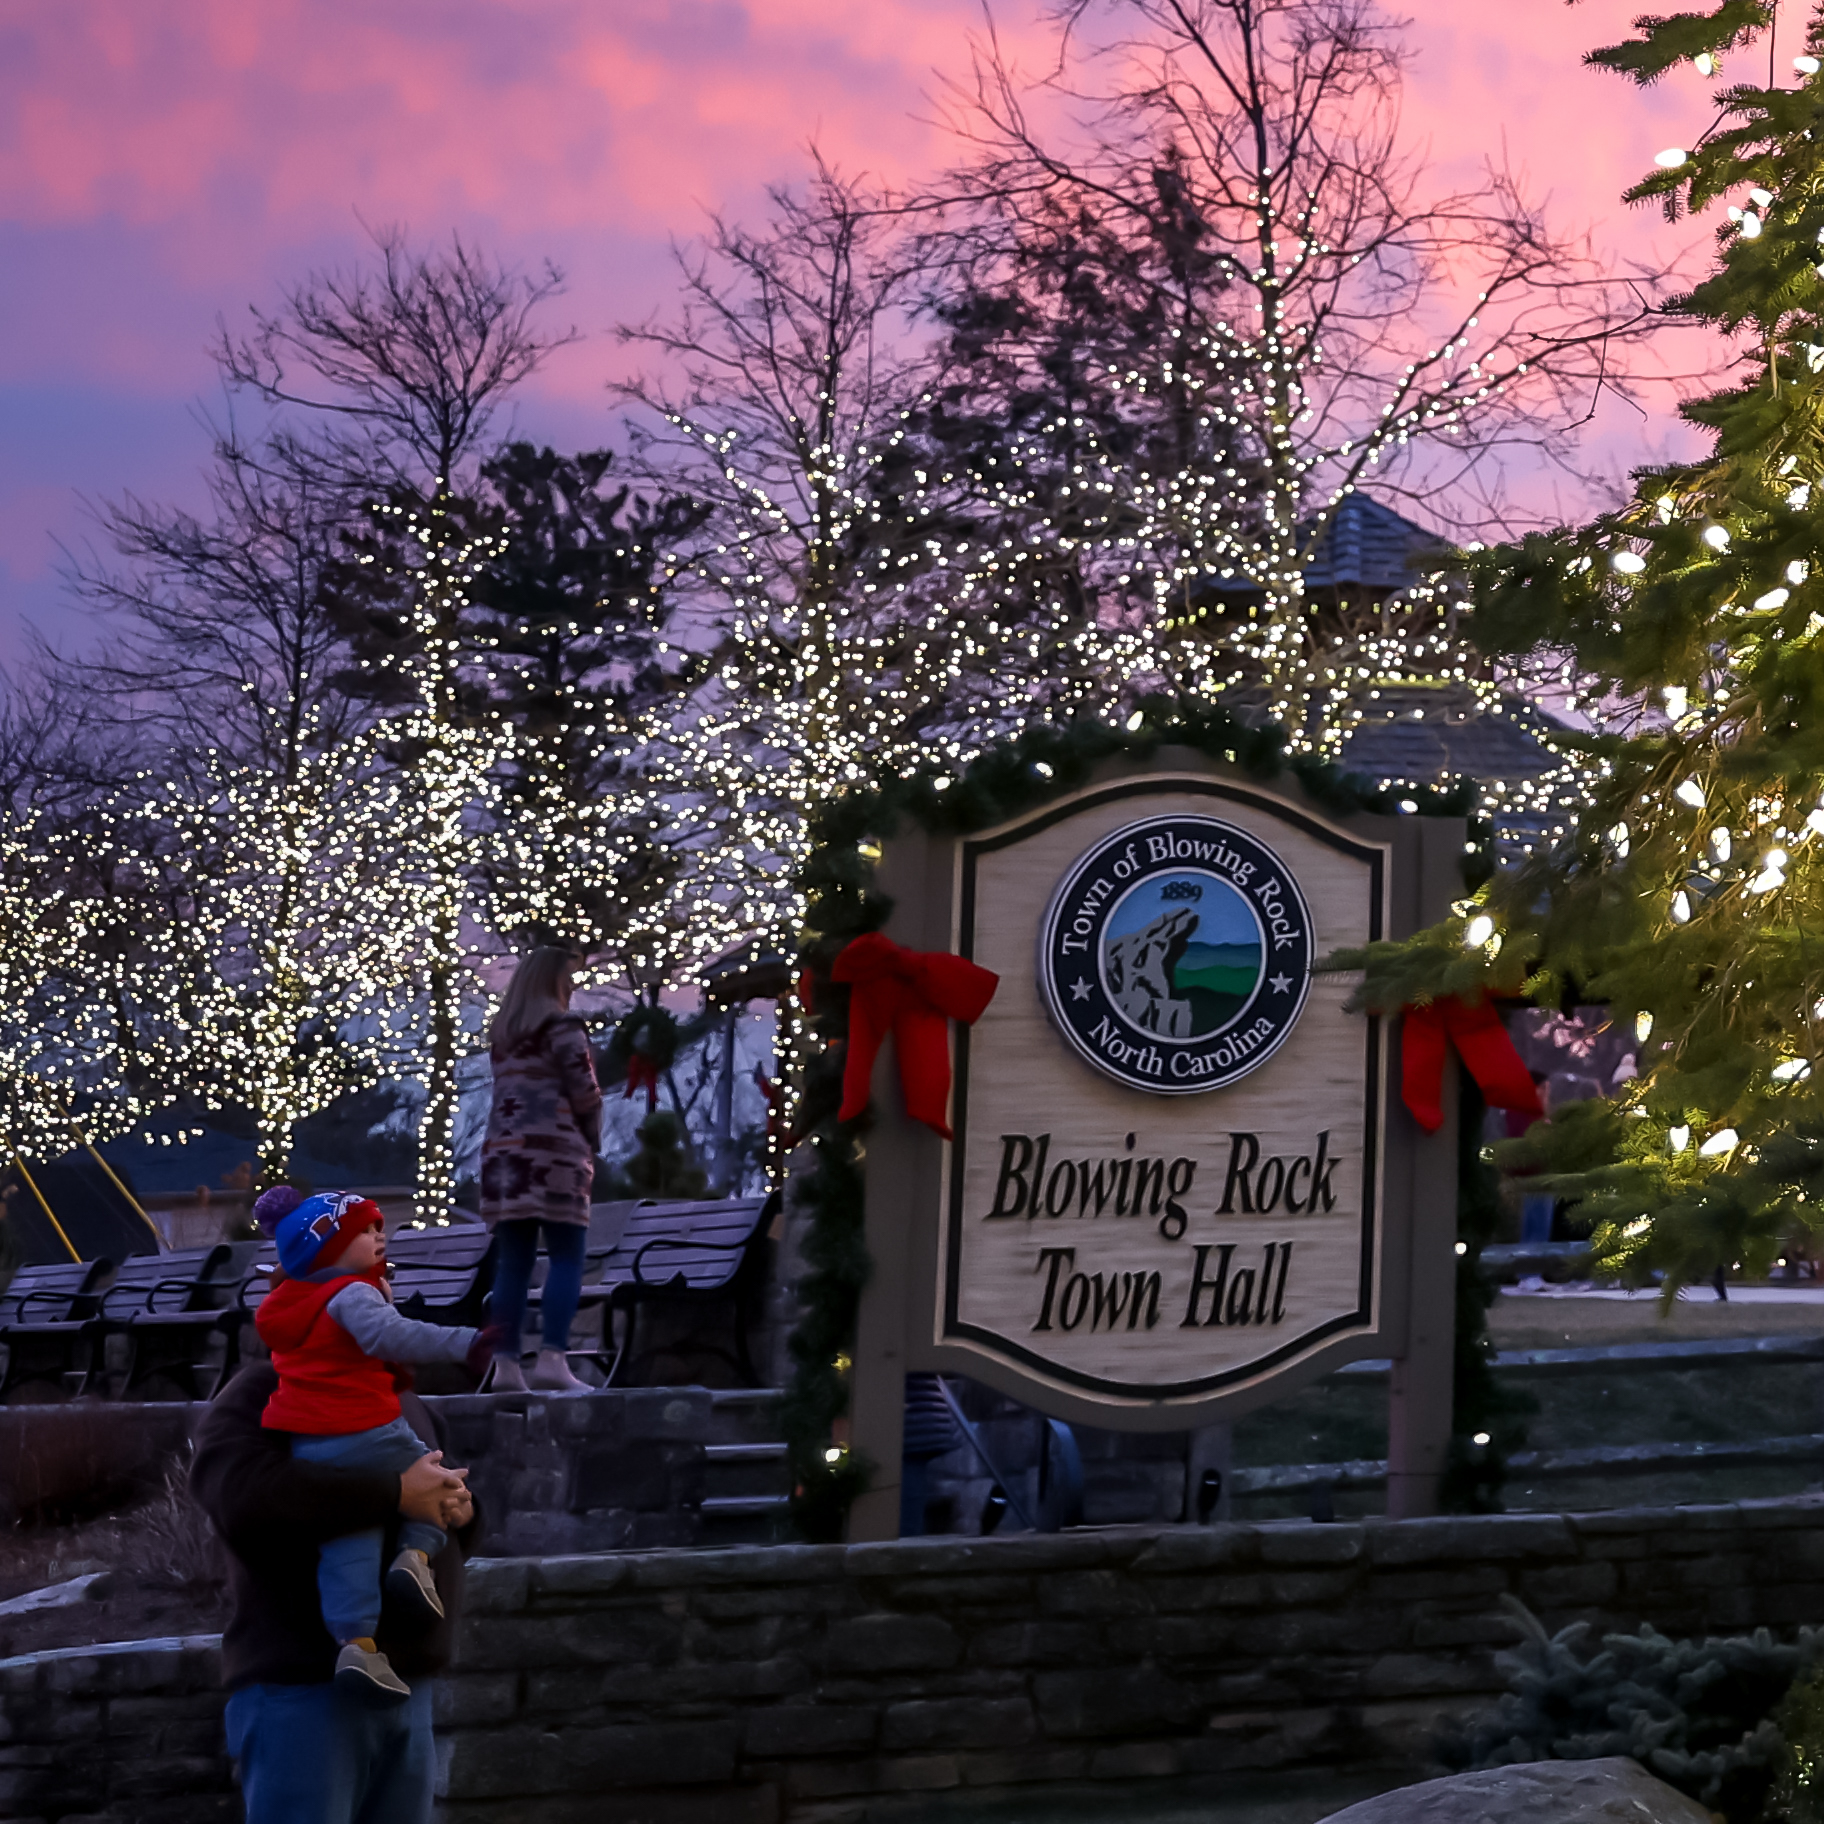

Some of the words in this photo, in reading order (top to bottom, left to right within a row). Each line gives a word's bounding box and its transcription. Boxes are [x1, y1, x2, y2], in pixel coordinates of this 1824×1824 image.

[1062, 877, 1115, 956] Town
[1113, 843, 1141, 878] of
[1145, 831, 1258, 887] Blowing
[1253, 877, 1300, 951] Rock
[1160, 880, 1203, 903] 1889
[1088, 1014, 1163, 1077] North
[1170, 1016, 1275, 1077] Carolina
[985, 1131, 1197, 1240] Blowing
[1214, 1129, 1343, 1215] Rock
[1031, 1246, 1161, 1332] Town
[1179, 1241, 1293, 1328] Hall
